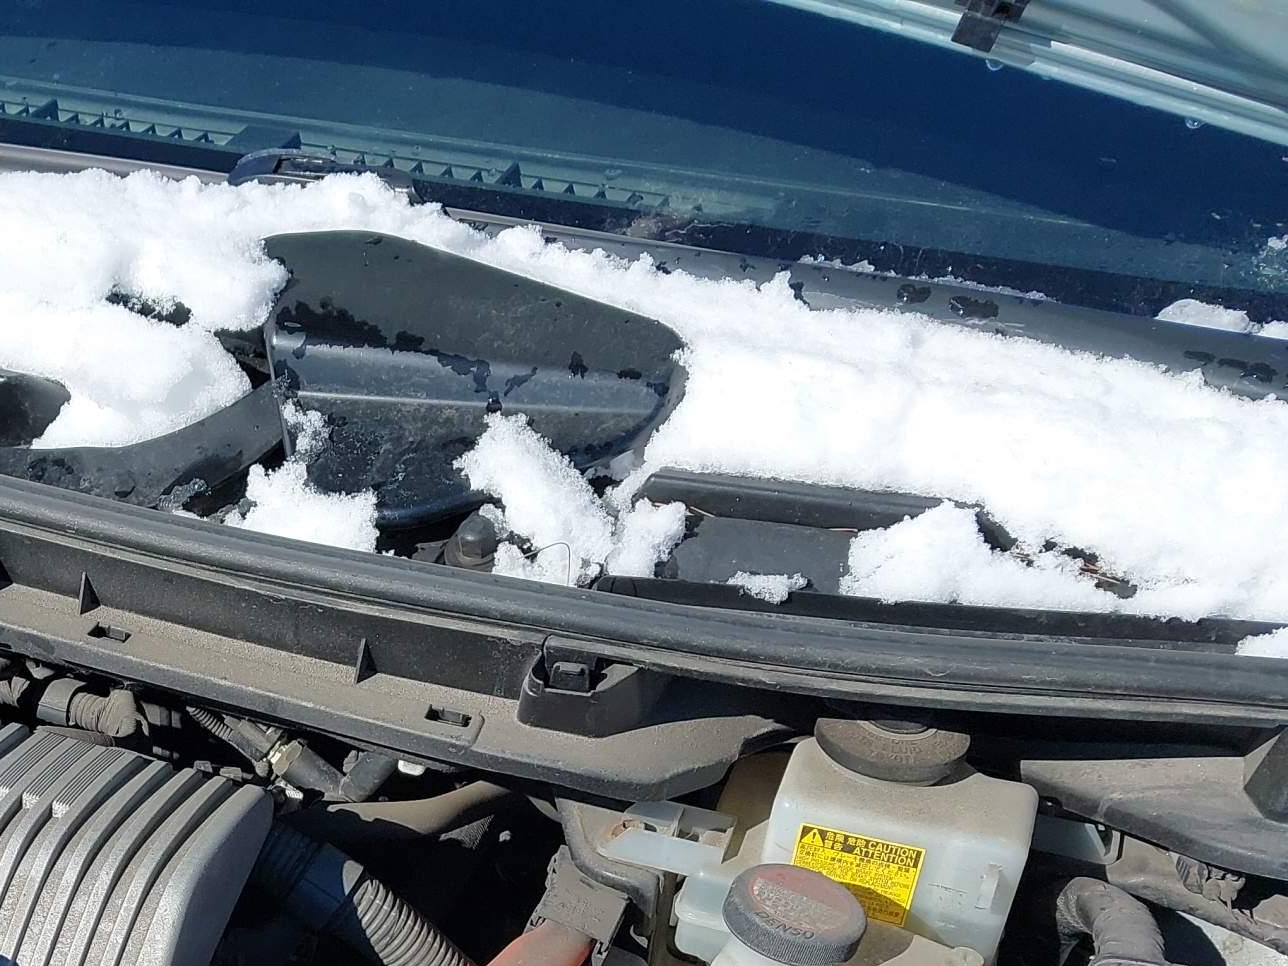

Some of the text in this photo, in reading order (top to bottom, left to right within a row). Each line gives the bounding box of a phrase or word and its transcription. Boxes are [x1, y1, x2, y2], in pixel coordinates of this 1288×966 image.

[851, 845, 915, 867] ATTENTION
[867, 840, 917, 859] CAUTION
[754, 910, 816, 940] DENSO
